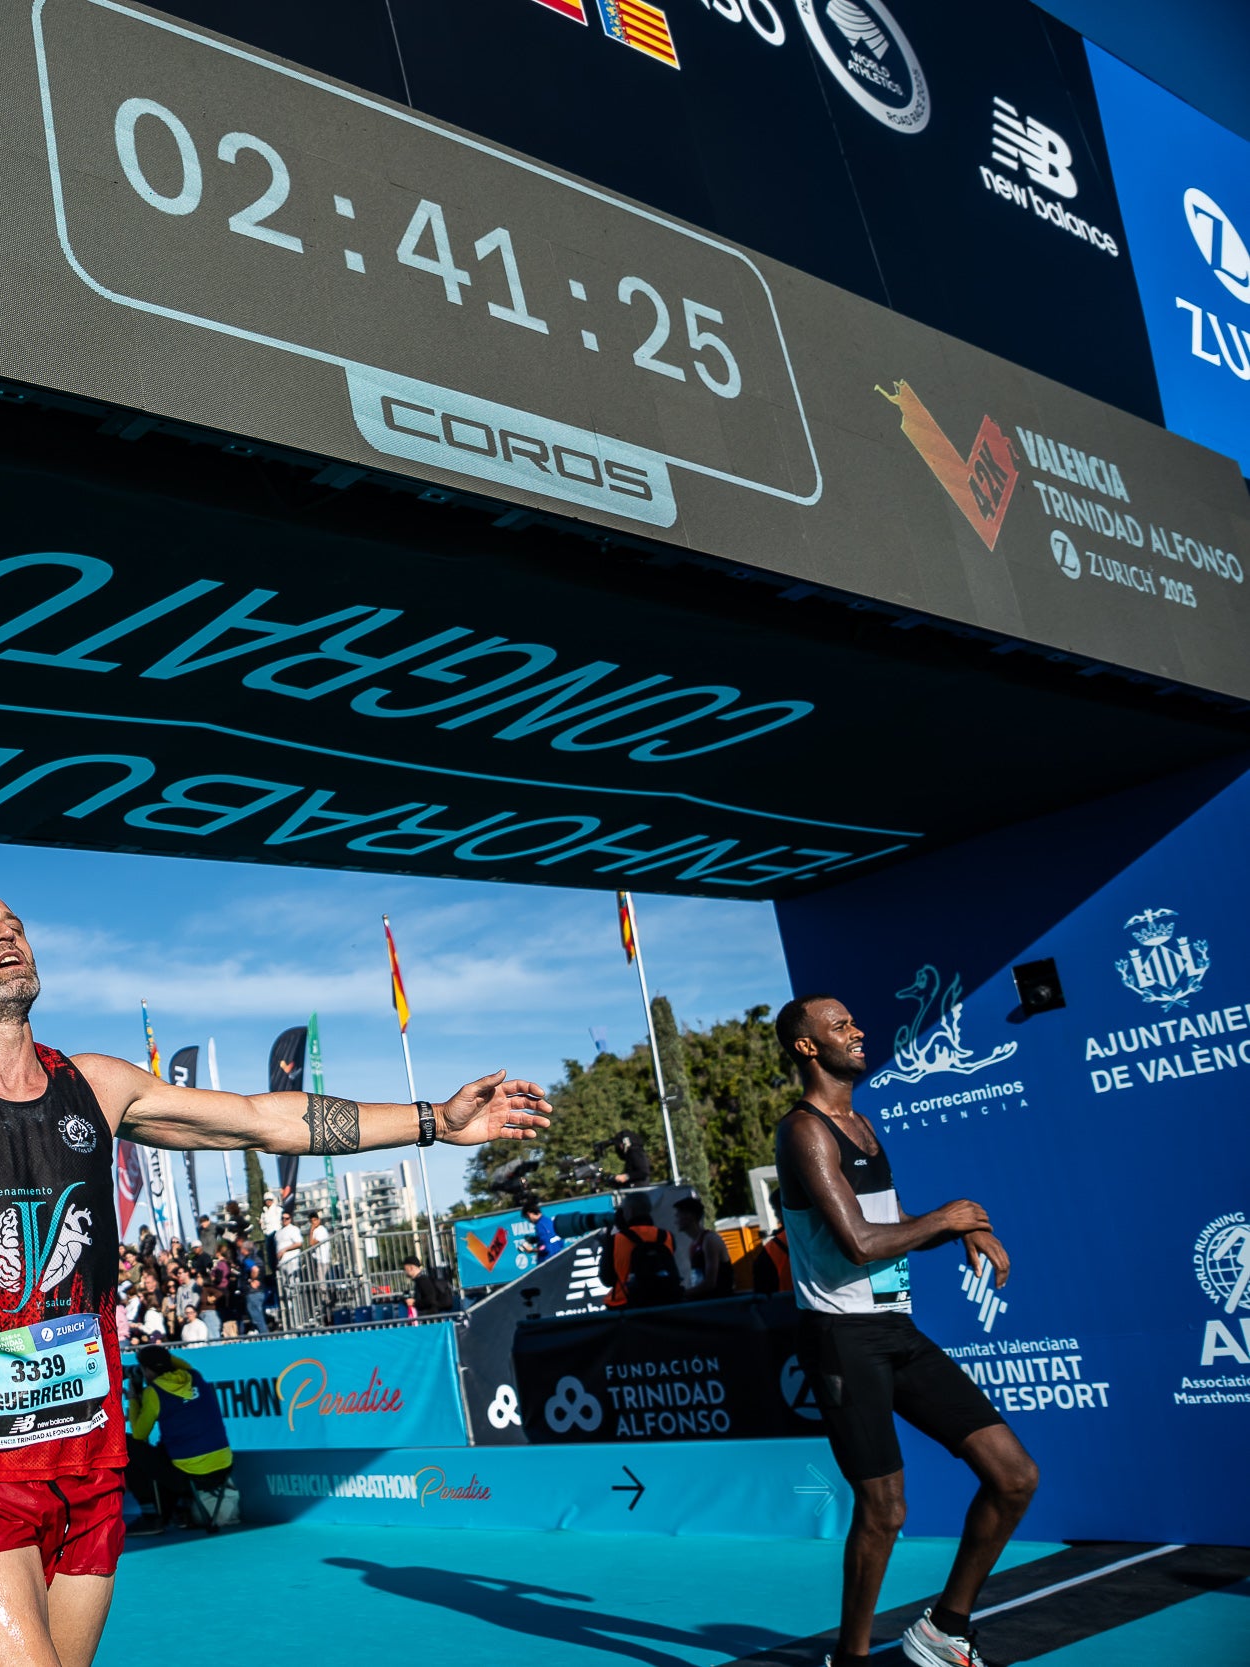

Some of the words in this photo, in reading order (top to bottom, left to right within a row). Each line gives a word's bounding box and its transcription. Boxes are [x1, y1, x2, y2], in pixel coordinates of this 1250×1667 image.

[847, 60, 903, 97] ATHLETICS
[850, 50, 890, 78] WORLD
[979, 165, 1029, 210] new
[1027, 186, 1120, 258] balance
[1175, 296, 1250, 381] ZU
[380, 394, 654, 501] COROS
[1015, 425, 1131, 504] VALENCIA
[1033, 480, 1145, 549] TRINIDAD
[1149, 523, 1244, 585] ALFONSO
[1085, 551, 1158, 596] ZURICH
[1158, 575, 1198, 609] 2025
[1084, 1003, 1250, 1061] AJUNTAME
[1090, 1065, 1134, 1094] DE
[880, 1098, 909, 1121] s.d.
[910, 1080, 1025, 1115] correcaminos
[883, 1098, 1029, 1135] VALENCIA
[1193, 1211, 1246, 1252] RUNNING
[1193, 1254, 1221, 1305] WORLD
[45, 1297, 72, 1307] salud
[56, 1320, 85, 1337] ZURICH
[997, 1336, 1080, 1356] Valenciana
[11, 1354, 66, 1383] 3339
[605, 1355, 720, 1381] FUNDACIÓN
[212, 1377, 282, 1418] THON
[276, 1357, 404, 1432] Paradise
[607, 1379, 726, 1410] TRINIDAD
[17, 1430, 45, 1445] TRINIDAD
[45, 1426, 75, 1439] ALFONSO
[50, 1415, 75, 1427] balance
[615, 1408, 731, 1437] ALFONSO
[266, 1474, 331, 1496] VALENCIA
[330, 1475, 417, 1499] MARATHON
[413, 1465, 492, 1508] Paradise
